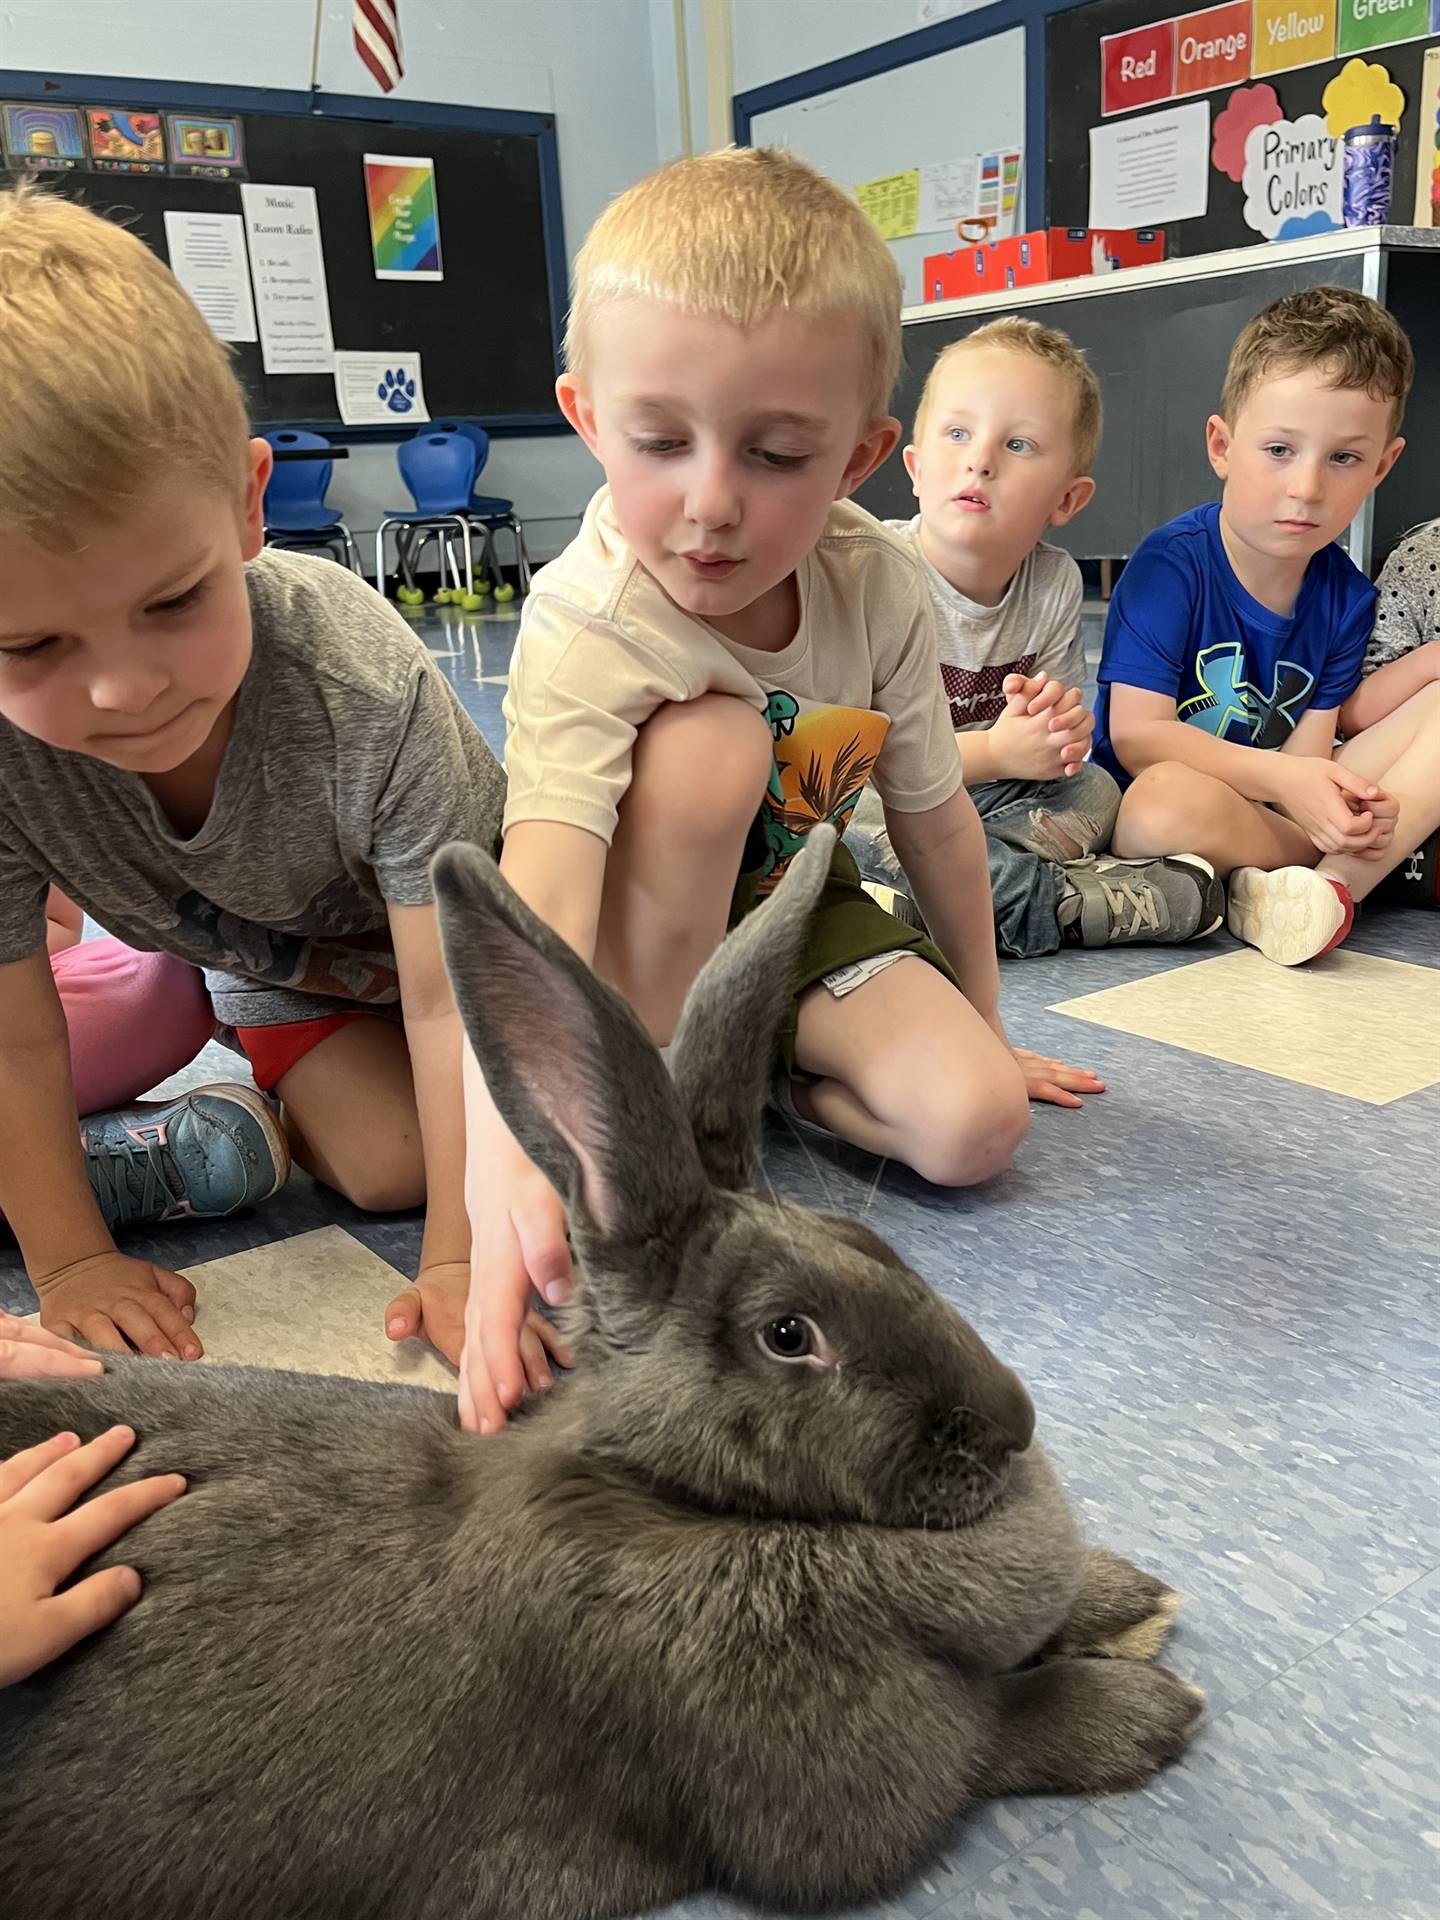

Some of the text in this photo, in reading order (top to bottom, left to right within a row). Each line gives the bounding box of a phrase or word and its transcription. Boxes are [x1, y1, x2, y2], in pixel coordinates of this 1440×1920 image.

[1265, 12, 1324, 46] Yellow
[1180, 32, 1247, 64] Orange
[1120, 50, 1157, 82] Red
[1264, 131, 1338, 171] Primary
[1268, 172, 1328, 216] Colors
